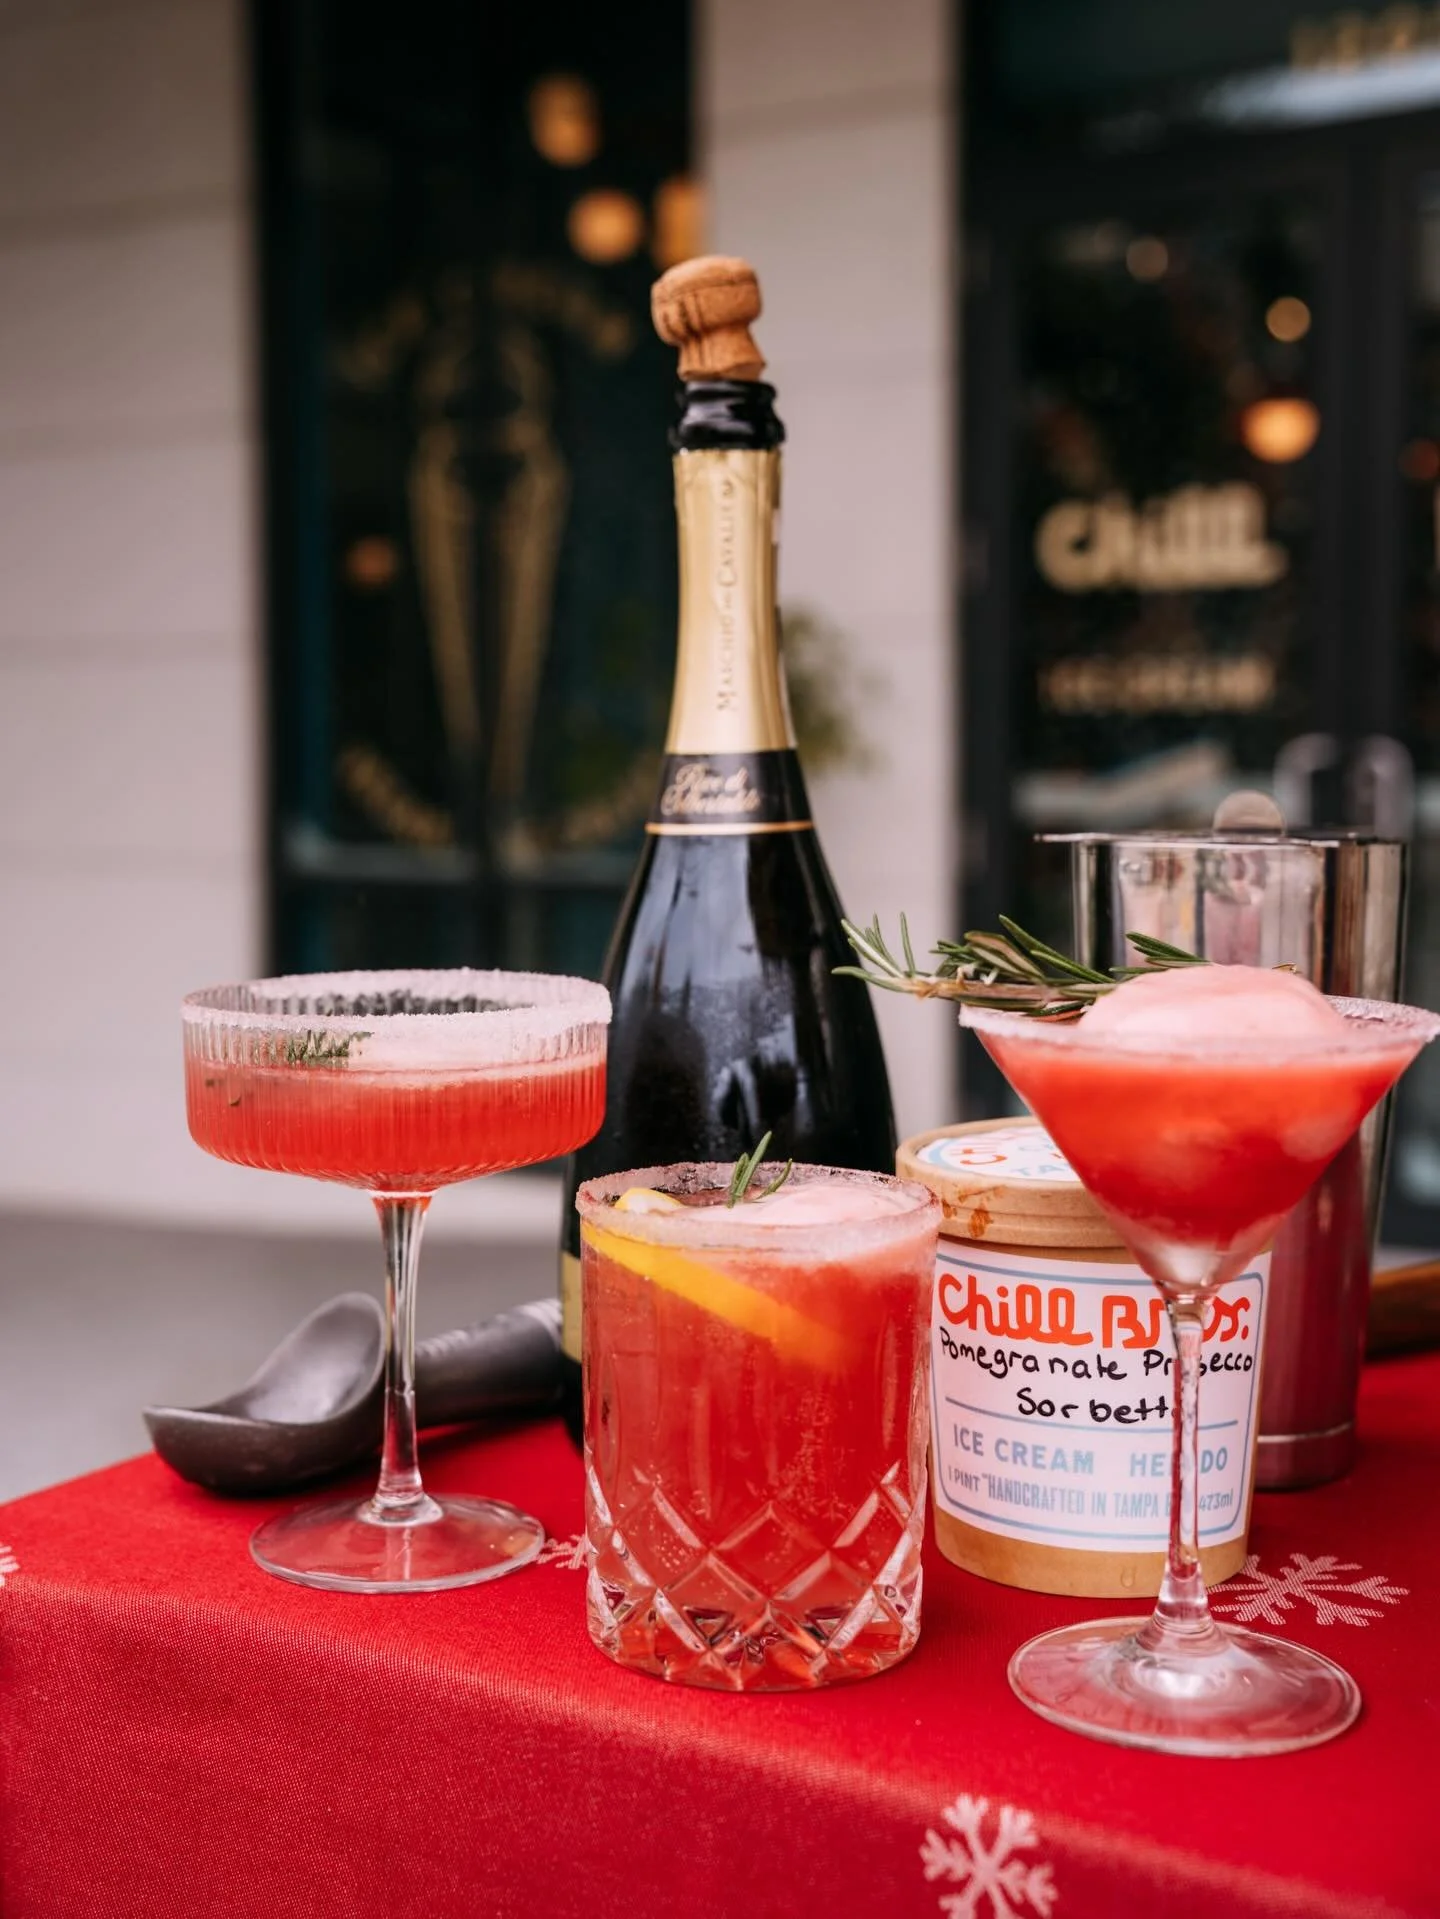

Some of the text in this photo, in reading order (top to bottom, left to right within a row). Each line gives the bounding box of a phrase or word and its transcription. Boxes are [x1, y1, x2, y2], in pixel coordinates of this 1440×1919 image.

[938, 1273, 1094, 1346] Chill
[1143, 1349, 1253, 1378] Prsecco
[1016, 1387, 1178, 1424] Sorbett
[953, 1423, 1229, 1477] ICE CREAM HEDO
[954, 1468, 981, 1492] PINT
[1091, 1491, 1107, 1516] IN
[1113, 1493, 1160, 1519] TAMPA
[1199, 1488, 1234, 1511] 473ml
